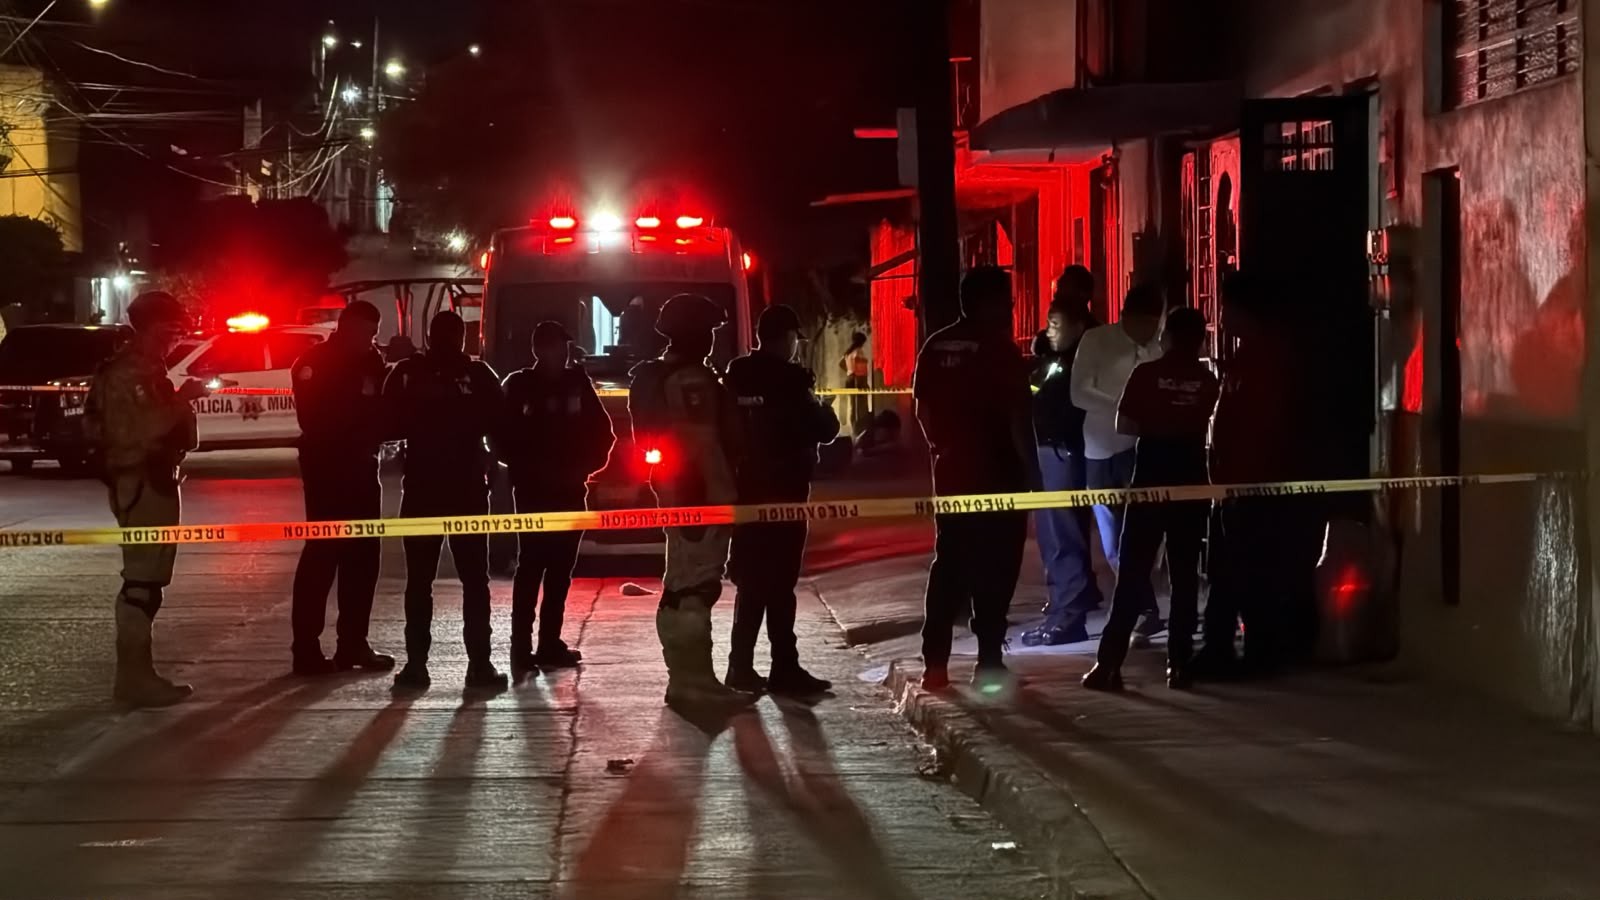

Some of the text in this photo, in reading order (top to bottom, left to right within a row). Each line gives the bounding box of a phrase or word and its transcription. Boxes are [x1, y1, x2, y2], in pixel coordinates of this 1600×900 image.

[268, 396, 297, 411] MUN
[443, 517, 544, 532] PRECAUCION
[601, 511, 702, 527] PRECAUCION
[122, 527, 225, 542] PRECAUCION
[283, 523, 386, 538] PRECAUCION
